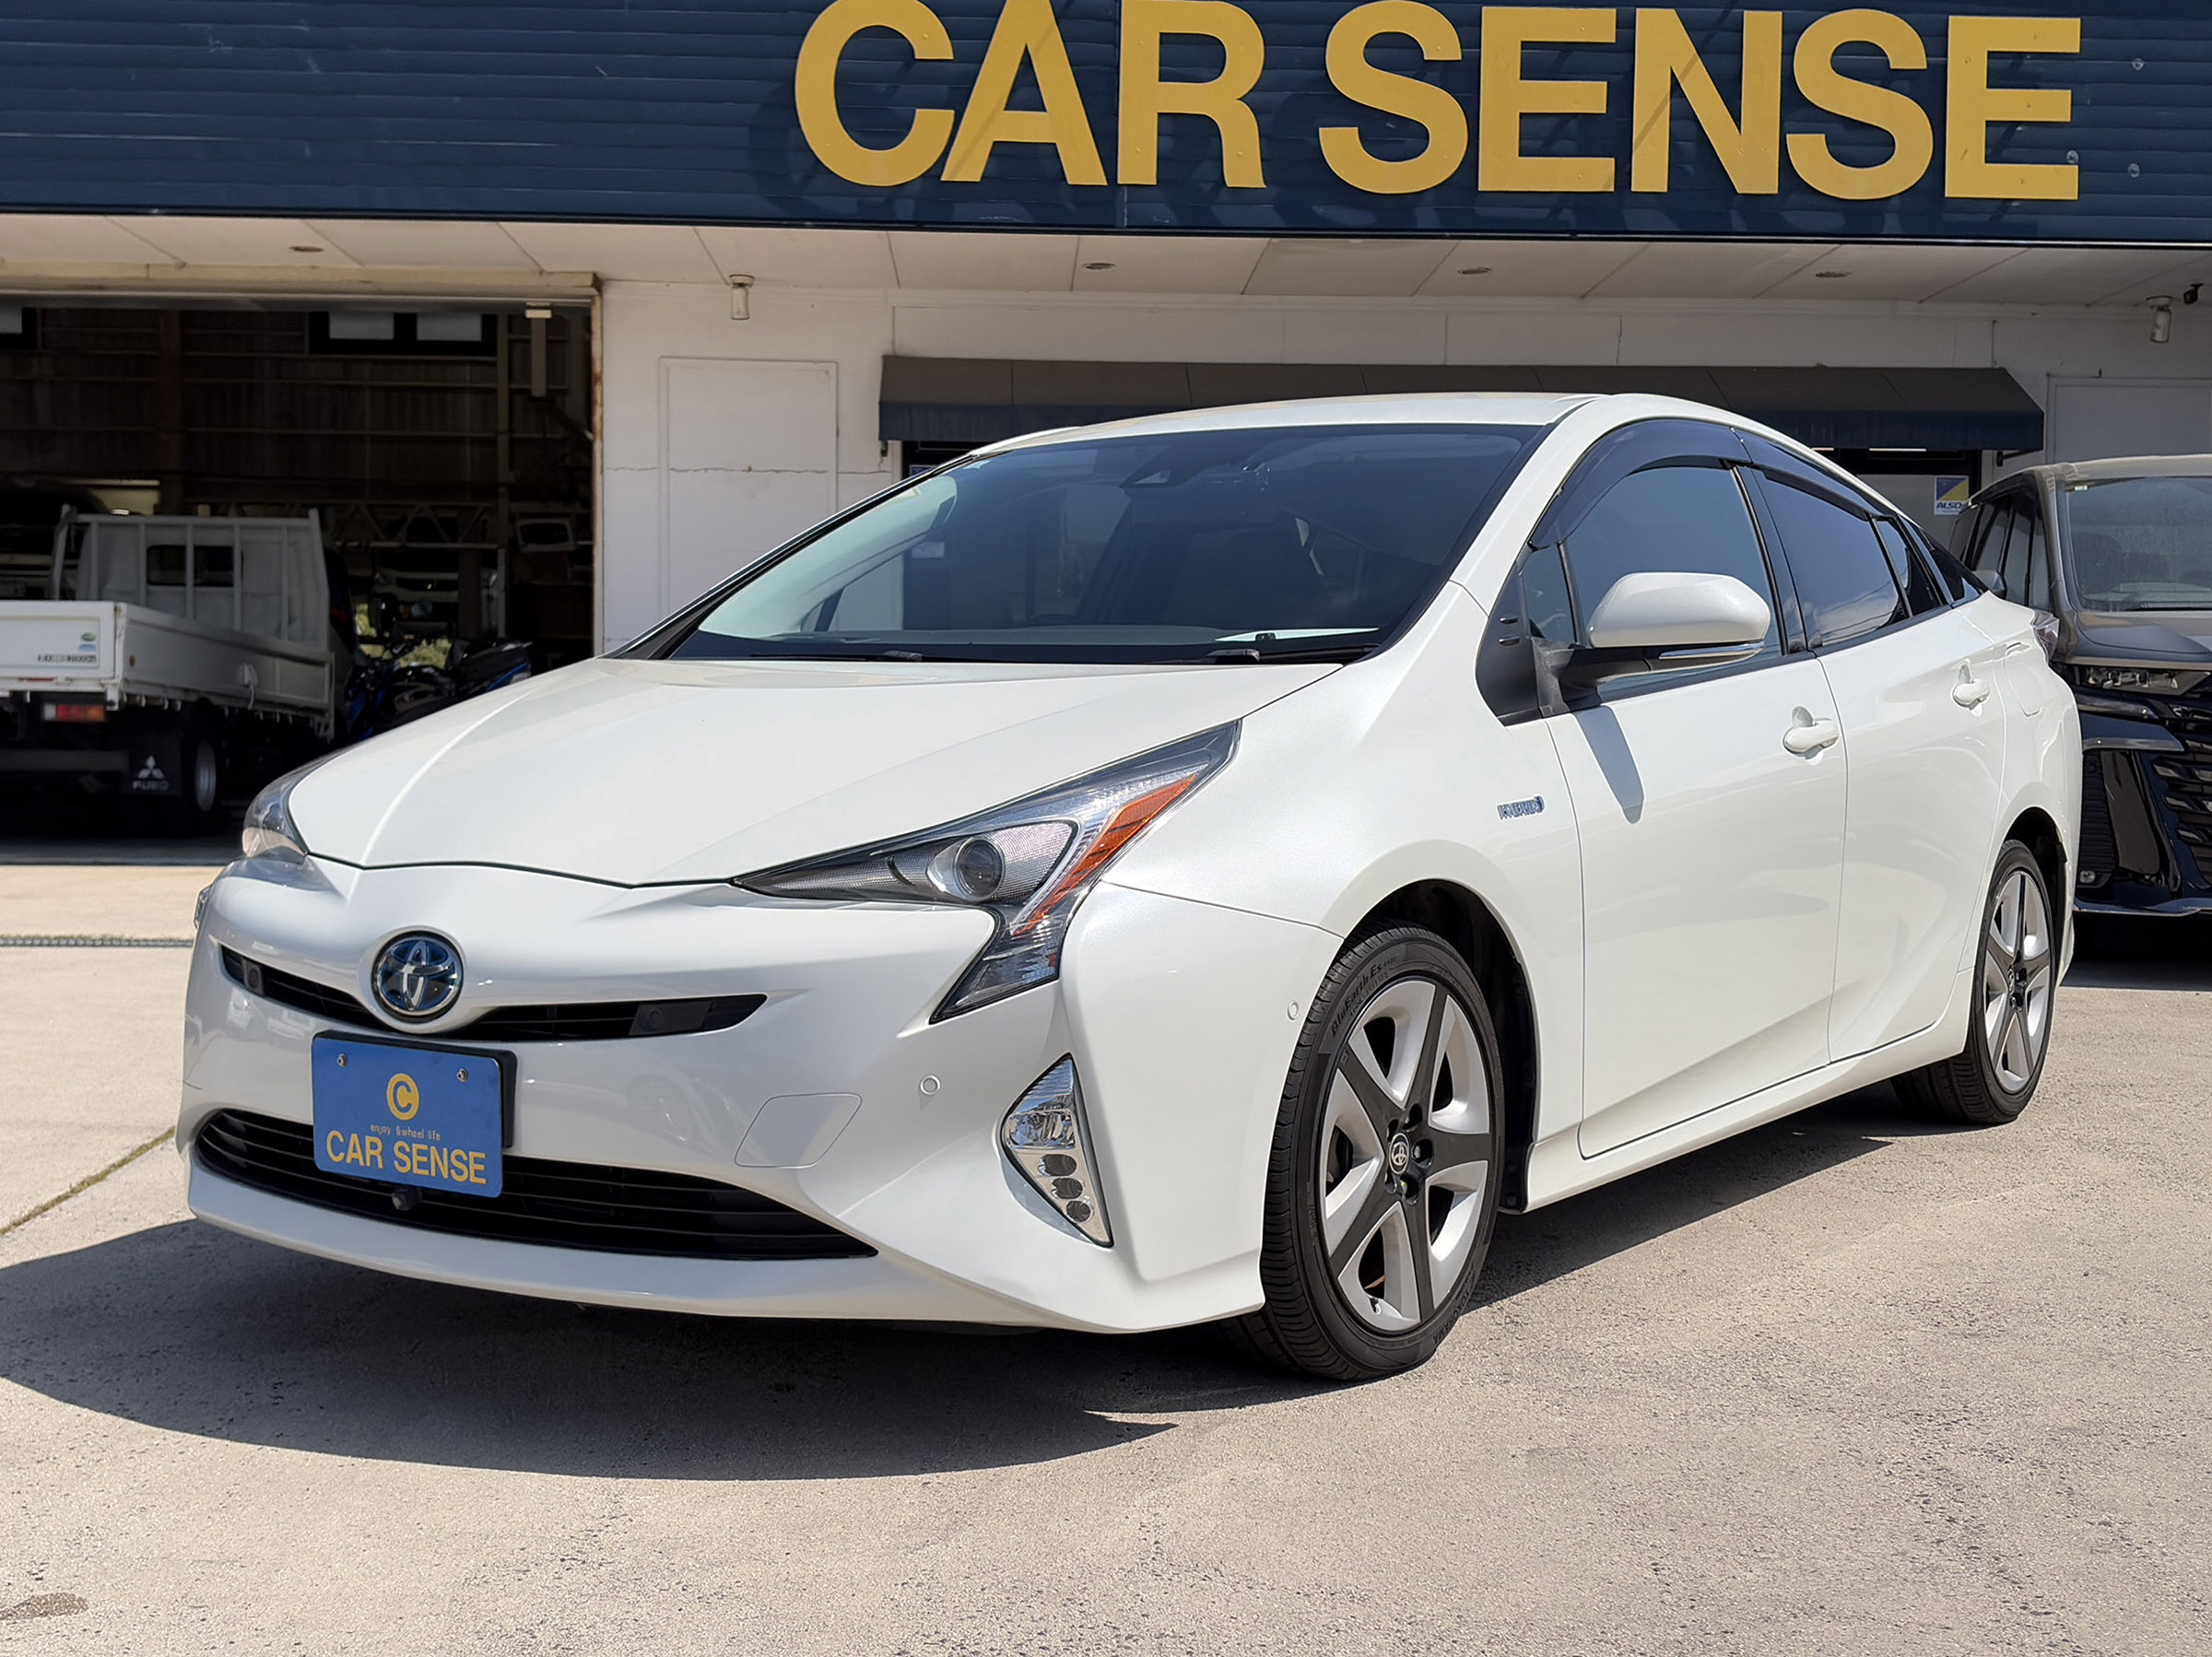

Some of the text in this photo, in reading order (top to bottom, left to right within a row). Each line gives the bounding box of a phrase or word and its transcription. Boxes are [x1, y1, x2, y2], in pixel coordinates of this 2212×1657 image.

[794, 0, 2081, 201] CAR SENSE
[1936, 501, 1966, 510] ALSO
[371, 1123, 391, 1135] enjoy
[428, 1130, 441, 1141] life
[326, 1130, 487, 1184] CAR SENSE
